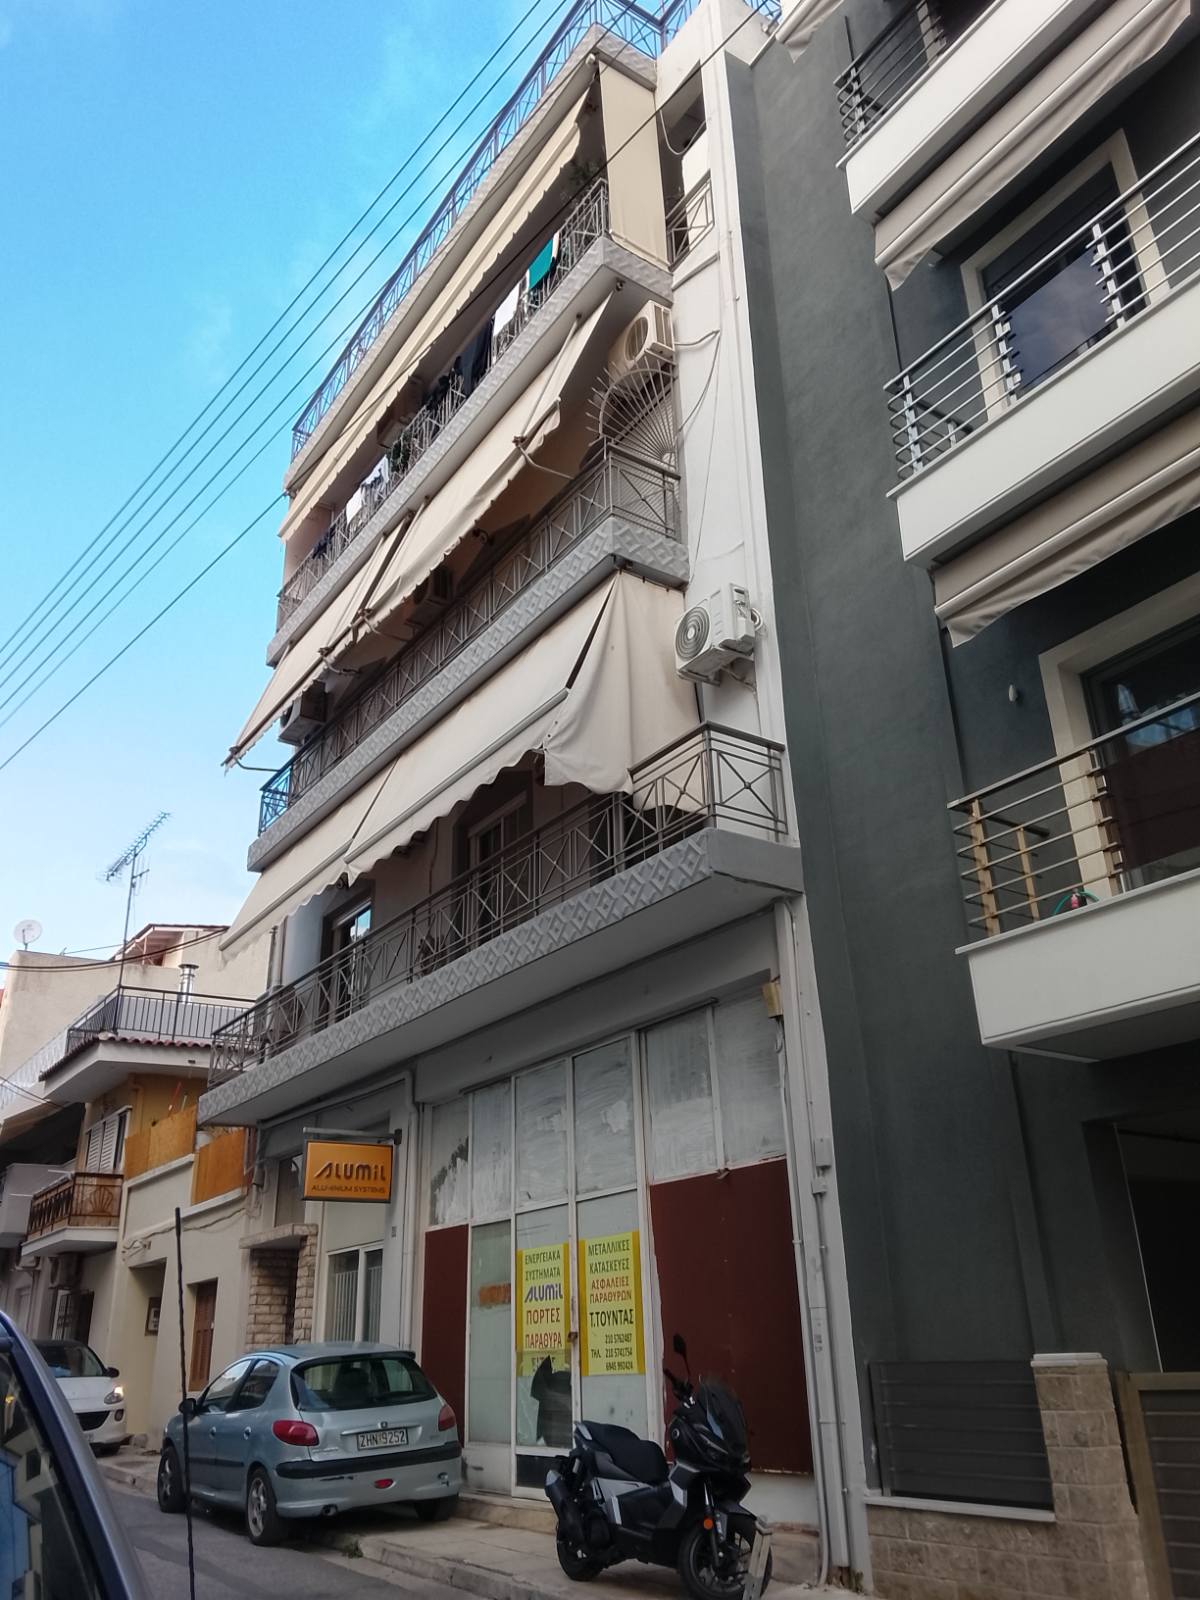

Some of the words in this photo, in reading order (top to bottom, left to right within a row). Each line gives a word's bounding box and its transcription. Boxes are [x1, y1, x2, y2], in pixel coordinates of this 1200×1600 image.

[313, 1160, 386, 1182] ALUMIL
[588, 1239, 630, 1257] ΜΕΤΑΛΛΙΚΕΣ
[525, 1249, 561, 1265] ΕΝΕΡΓΕΙΑΚΑ
[525, 1266, 561, 1281] ΣΥΣΤΗΜΑΤΑ
[589, 1258, 630, 1275] ΚΑΤΑΣΚΕΥΕΣ
[591, 1276, 629, 1291] ΑΣΦΑΛΕΙΕΣ
[524, 1282, 563, 1303] ALUMIL
[589, 1290, 632, 1305] ΠΑΡΑΘΥΡΩΝ
[526, 1307, 561, 1326] ΠΟΡΤΕΣ
[589, 1308, 634, 1329] Τ.ΤΟΥΝΤΑΣ
[525, 1333, 563, 1350] ΠΑΡΑΘΥΡΑ
[605, 1334, 613, 1344] 210
[605, 1347, 613, 1358] 210
